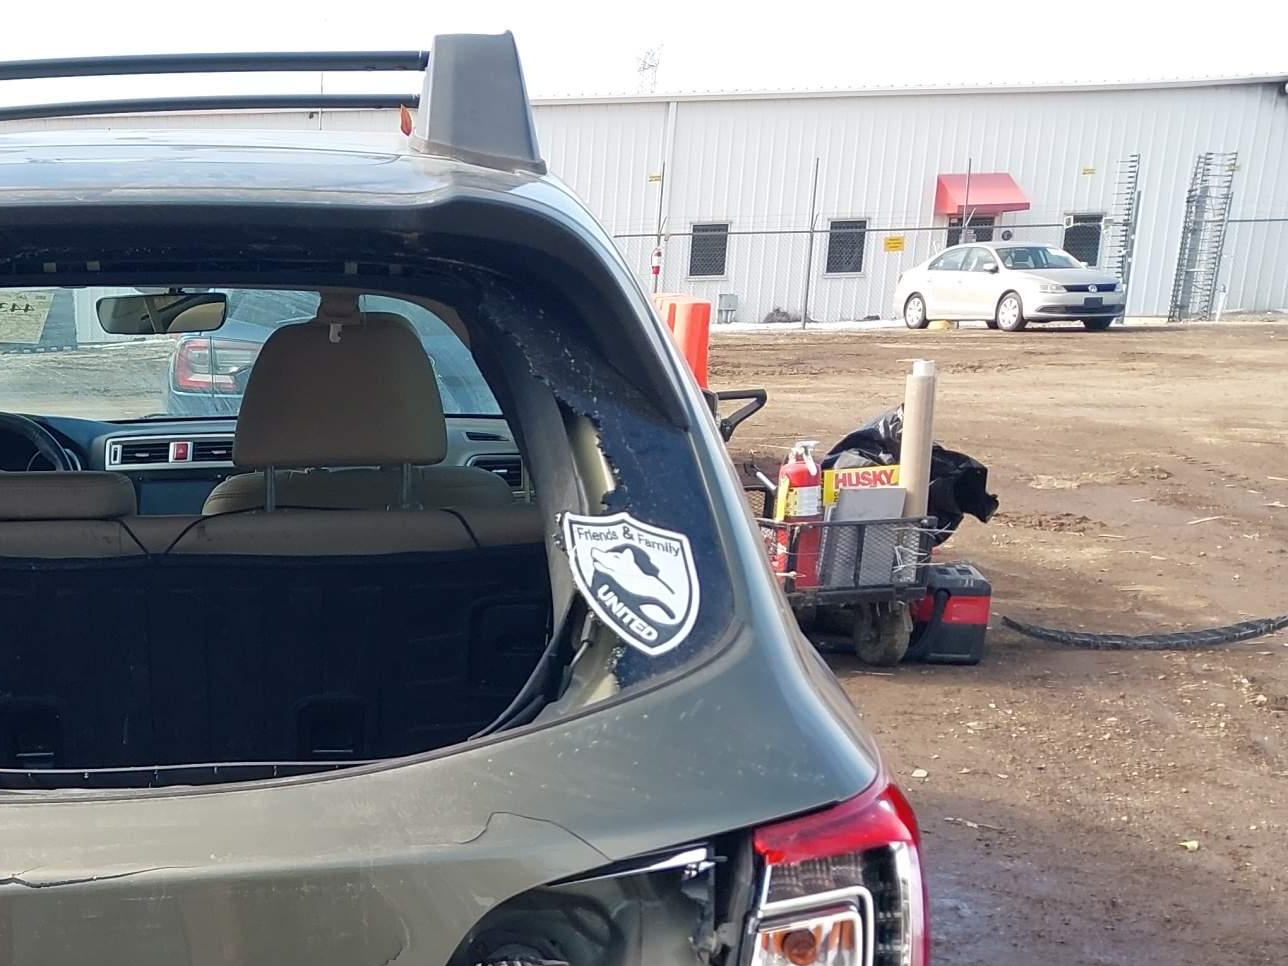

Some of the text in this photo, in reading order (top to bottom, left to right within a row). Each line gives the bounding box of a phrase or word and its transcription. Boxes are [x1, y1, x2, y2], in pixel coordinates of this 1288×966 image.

[834, 469, 895, 489] HUSKY
[577, 526, 680, 557] Friends & Family
[597, 584, 658, 641] UNITED
